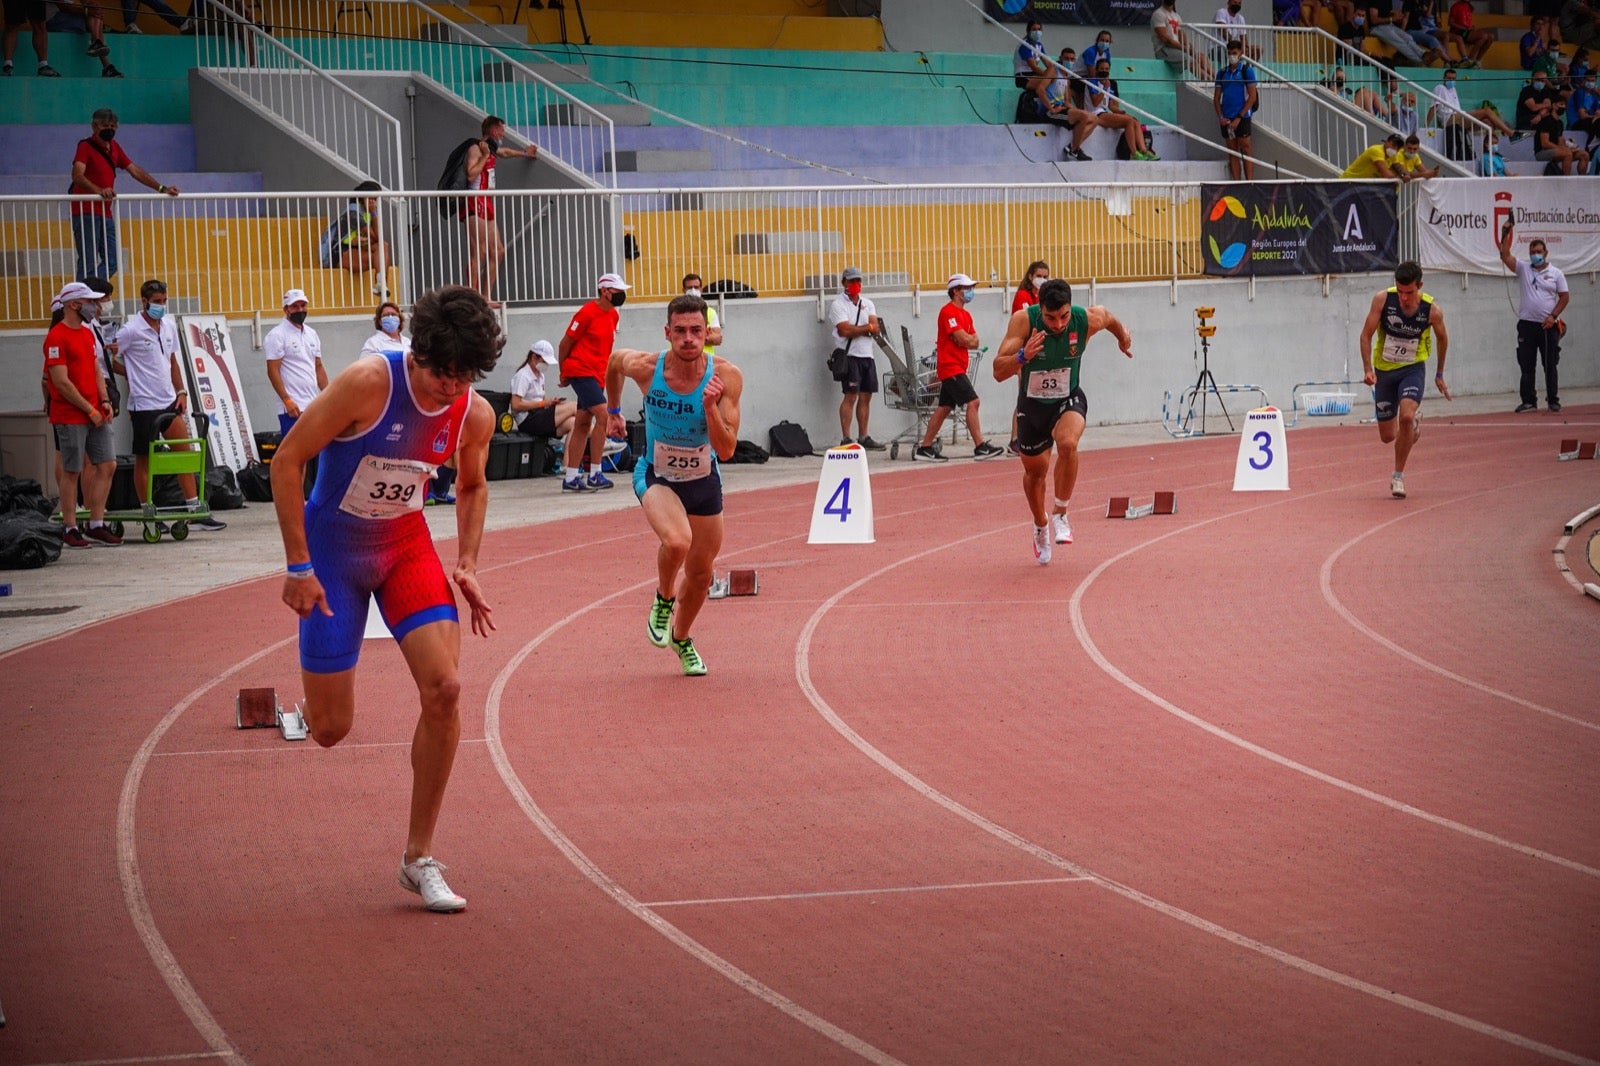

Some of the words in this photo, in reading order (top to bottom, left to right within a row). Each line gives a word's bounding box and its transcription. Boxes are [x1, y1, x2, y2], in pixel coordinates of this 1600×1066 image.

[1034, 1, 1061, 10] DEPORTE
[1061, 2, 1076, 11] 2021
[1252, 203, 1313, 231] Andalucía
[1428, 207, 1488, 235] Deportes
[1516, 207, 1564, 227] Diputación
[1566, 207, 1577, 224] de
[1251, 239, 1272, 250] Región
[1273, 239, 1297, 249] Europea
[1297, 238, 1307, 247] del
[1332, 244, 1346, 253] Junta
[1346, 243, 1353, 252] de
[1353, 241, 1376, 252] Andalucía
[1252, 251, 1281, 260] DEPORTE
[1282, 250, 1297, 260] 2021
[1041, 378, 1057, 389] 53
[646, 395, 695, 415] nerja
[219, 398, 242, 470] atletismofaa.es
[1249, 431, 1273, 470] 3
[667, 455, 700, 469] 255
[369, 482, 416, 502] 339
[823, 477, 852, 522] 4
